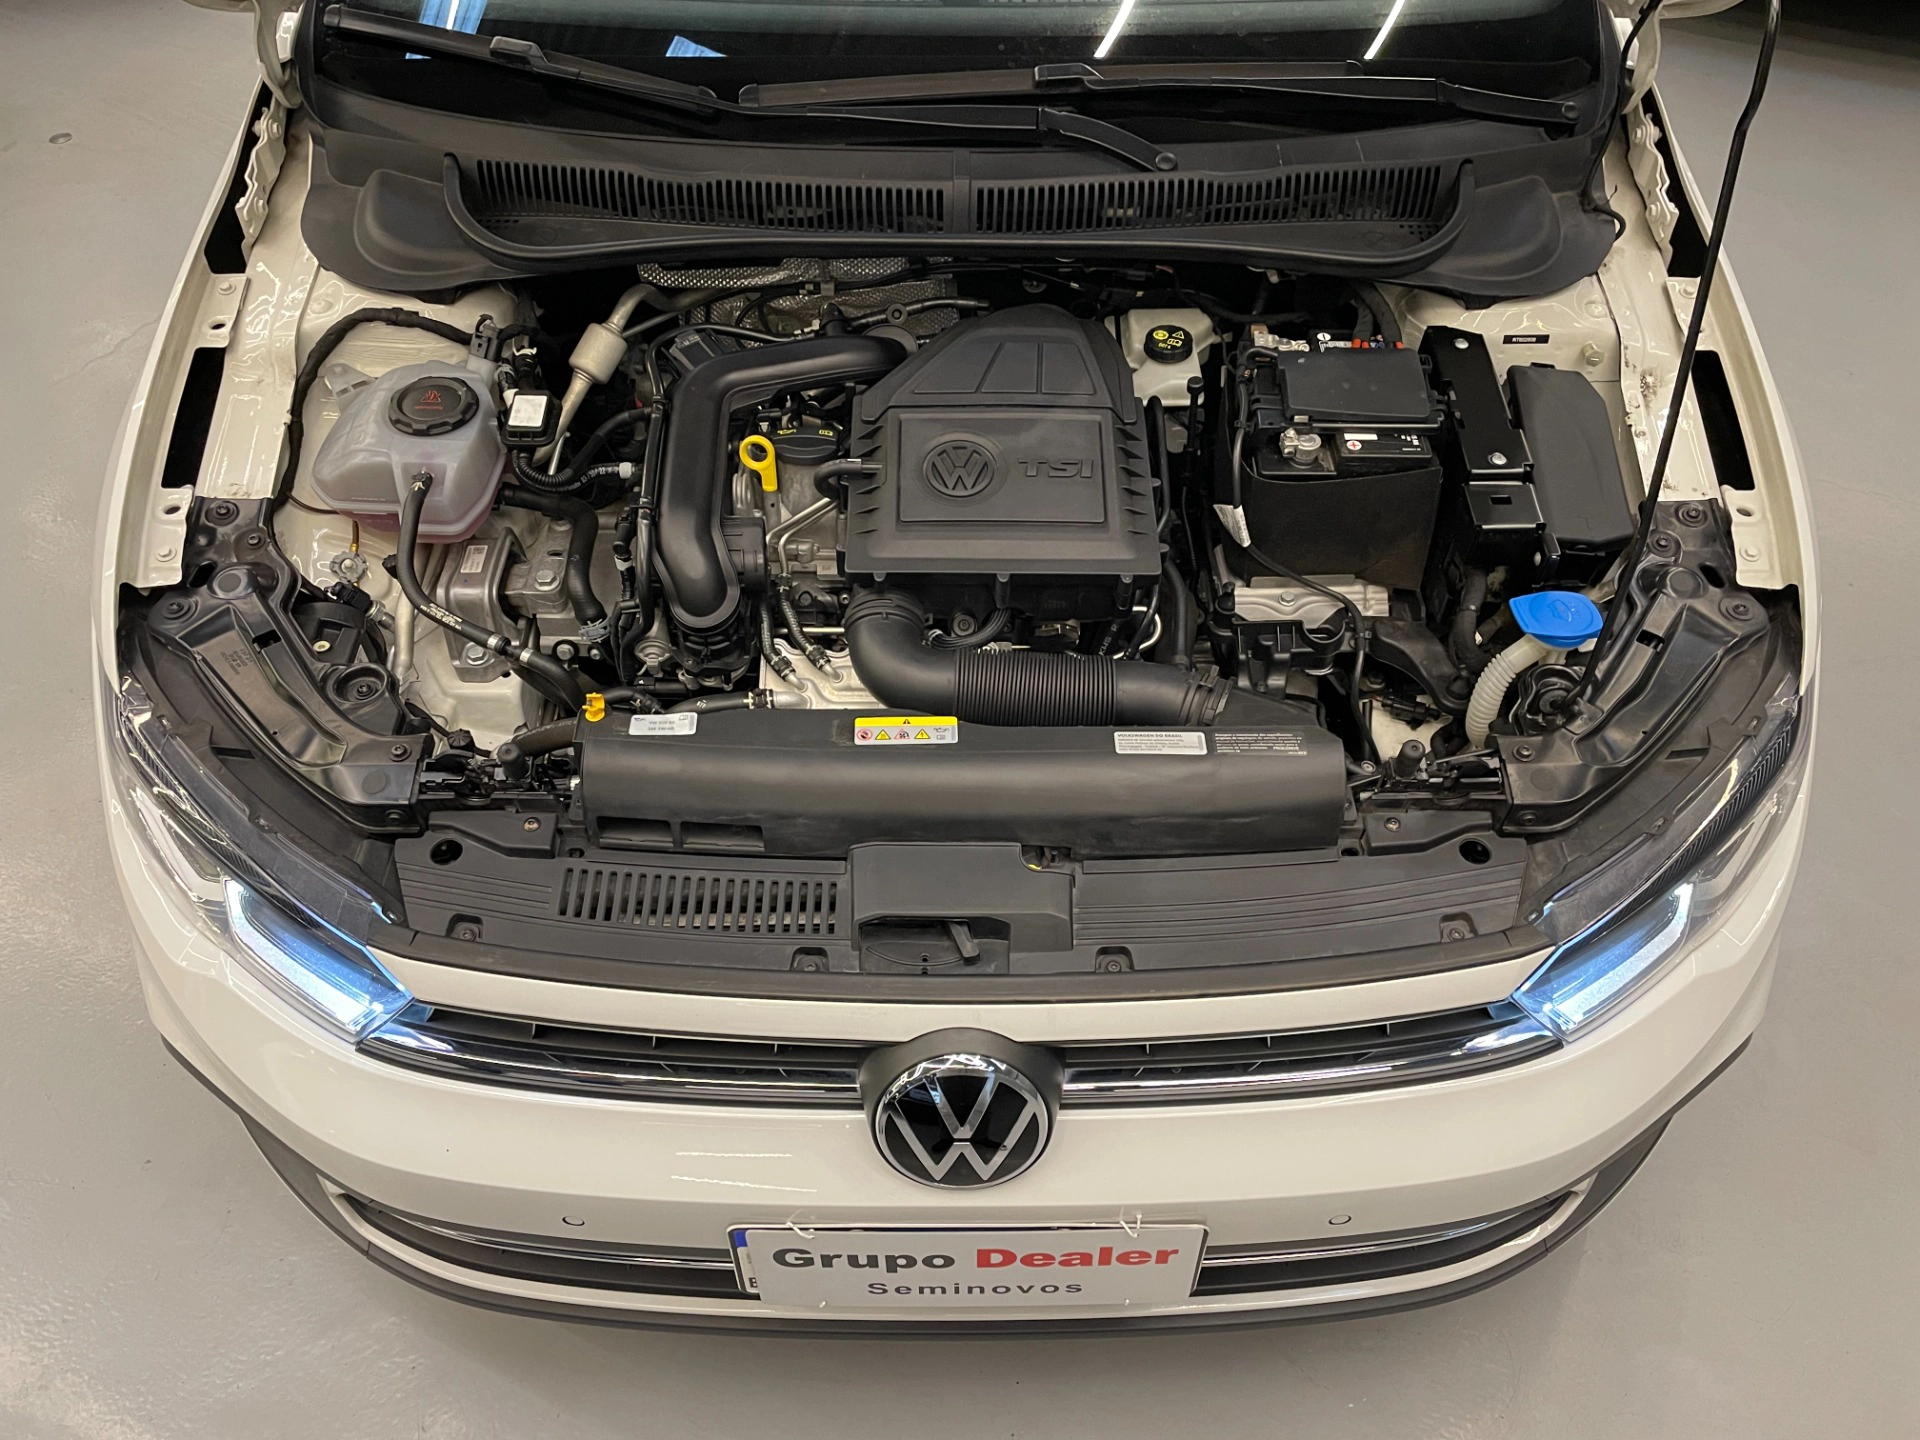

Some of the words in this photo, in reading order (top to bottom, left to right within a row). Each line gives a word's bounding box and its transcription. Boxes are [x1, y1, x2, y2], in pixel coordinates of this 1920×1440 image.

[1018, 459, 1094, 479] TSI
[773, 1248, 955, 1273] Grupo
[976, 1246, 1180, 1268] Dealer
[867, 1283, 1083, 1295] Seminovos
